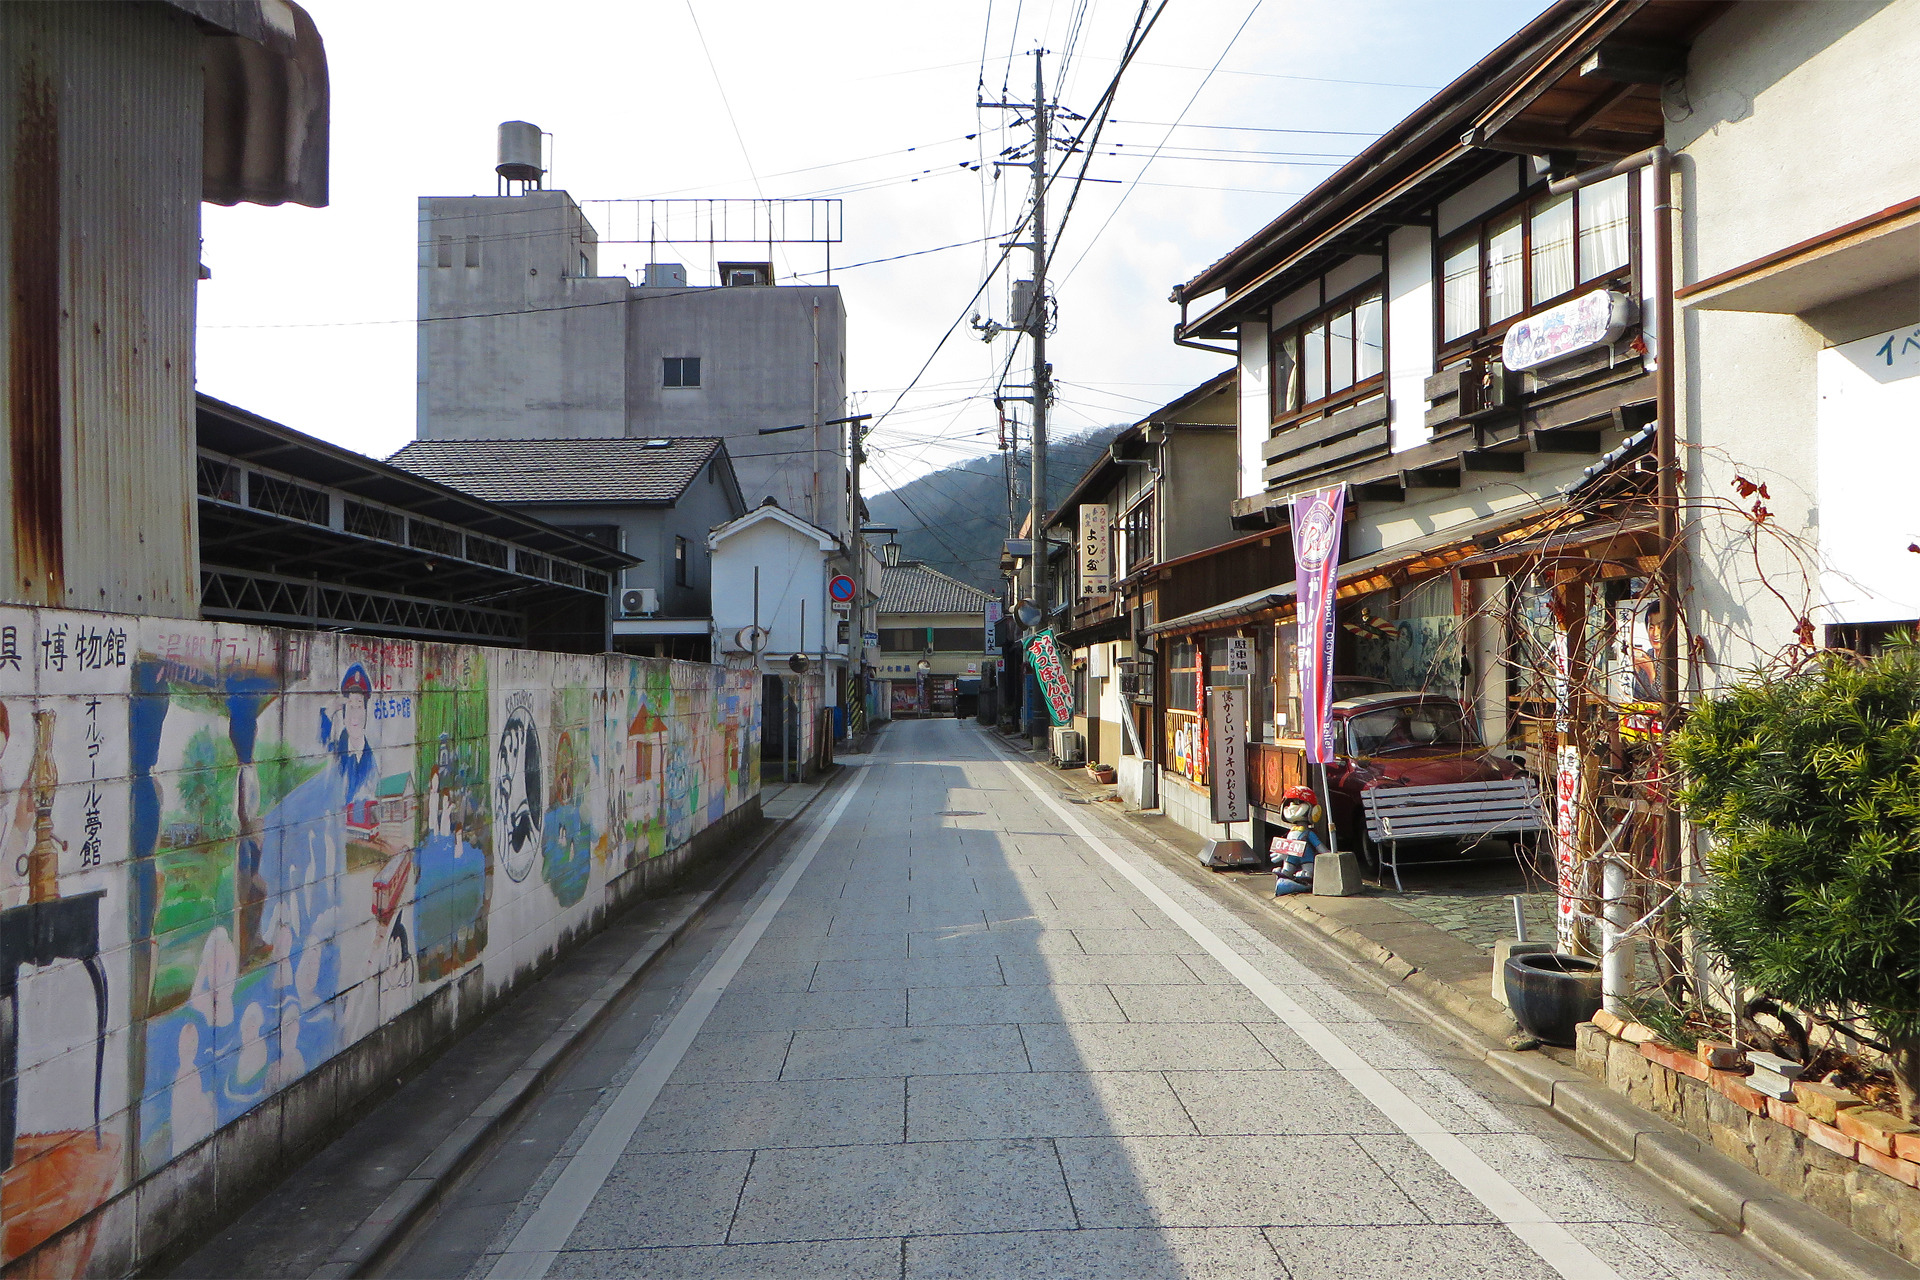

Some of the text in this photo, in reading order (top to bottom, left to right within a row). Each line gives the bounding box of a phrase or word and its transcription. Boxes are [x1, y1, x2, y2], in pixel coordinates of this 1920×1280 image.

[1328, 567, 1337, 584] We
[1325, 588, 1334, 627] support
[1324, 630, 1335, 677] Okayama
[373, 696, 412, 719] おもちゃ館
[1323, 722, 1331, 750] Belle!
[1221, 690, 1238, 820] 懐かしいブリキのおもちゃ
[79, 696, 105, 868] オルゴール夢館
[1275, 840, 1300, 853] OPEN
